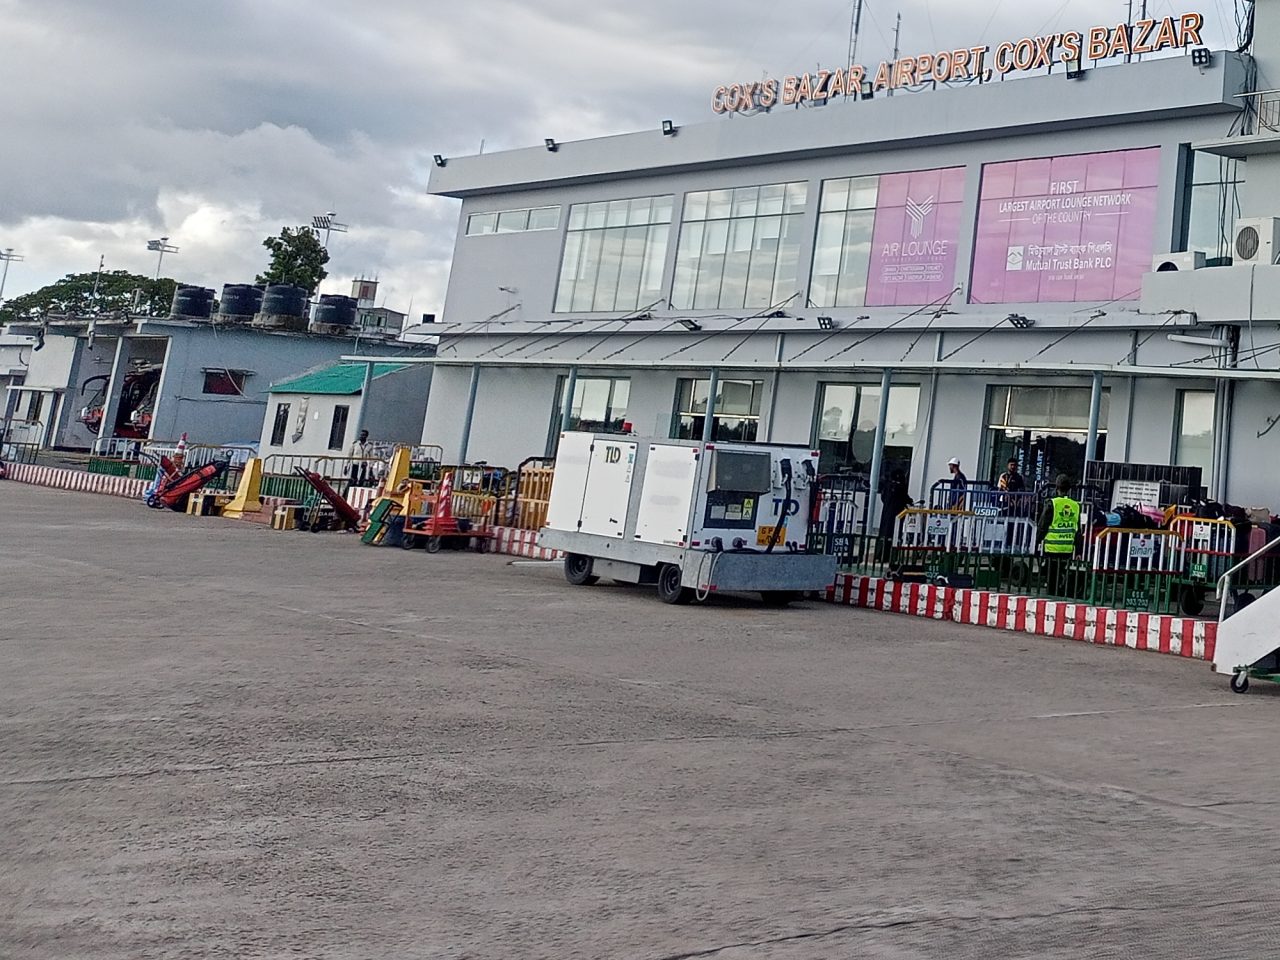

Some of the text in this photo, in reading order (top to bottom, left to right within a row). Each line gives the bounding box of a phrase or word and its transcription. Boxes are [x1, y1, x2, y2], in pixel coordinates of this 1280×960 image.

[711, 12, 1203, 114] COX'S BAZAR AIRPORT, COX'S BAZAR
[1050, 180, 1079, 195] FIRST
[999, 193, 1132, 213] LARGEST AIRPORT LOUNGE NETWORK
[1044, 212, 1057, 224] THE
[1058, 210, 1092, 223] COUNTRY
[901, 239, 949, 256] LOUNGE
[1025, 256, 1112, 271] Mutual Trust Bank PLC
[605, 445, 621, 464] TLD
[1130, 546, 1153, 556] Biman
